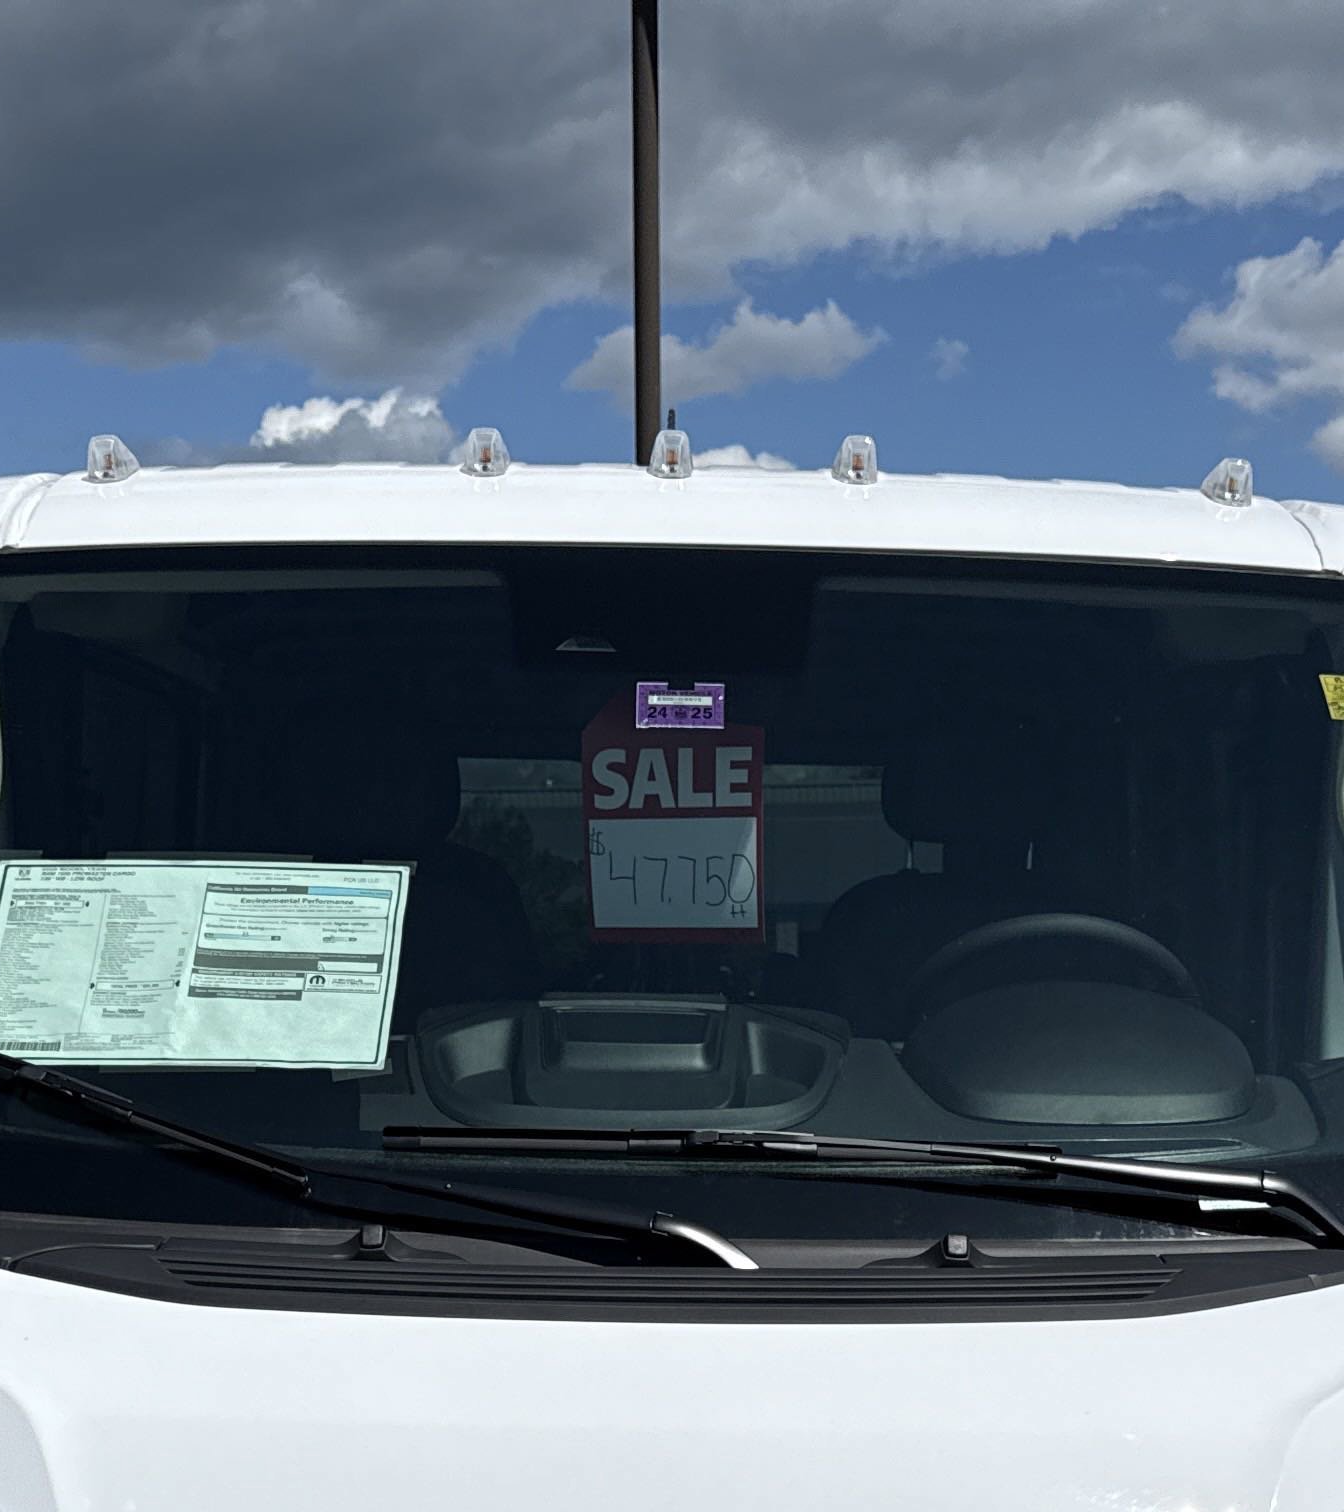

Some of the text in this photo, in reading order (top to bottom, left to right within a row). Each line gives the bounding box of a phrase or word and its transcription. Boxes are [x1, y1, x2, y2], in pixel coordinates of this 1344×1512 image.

[647, 706, 713, 719] 24 25
[591, 746, 753, 810] SALE
